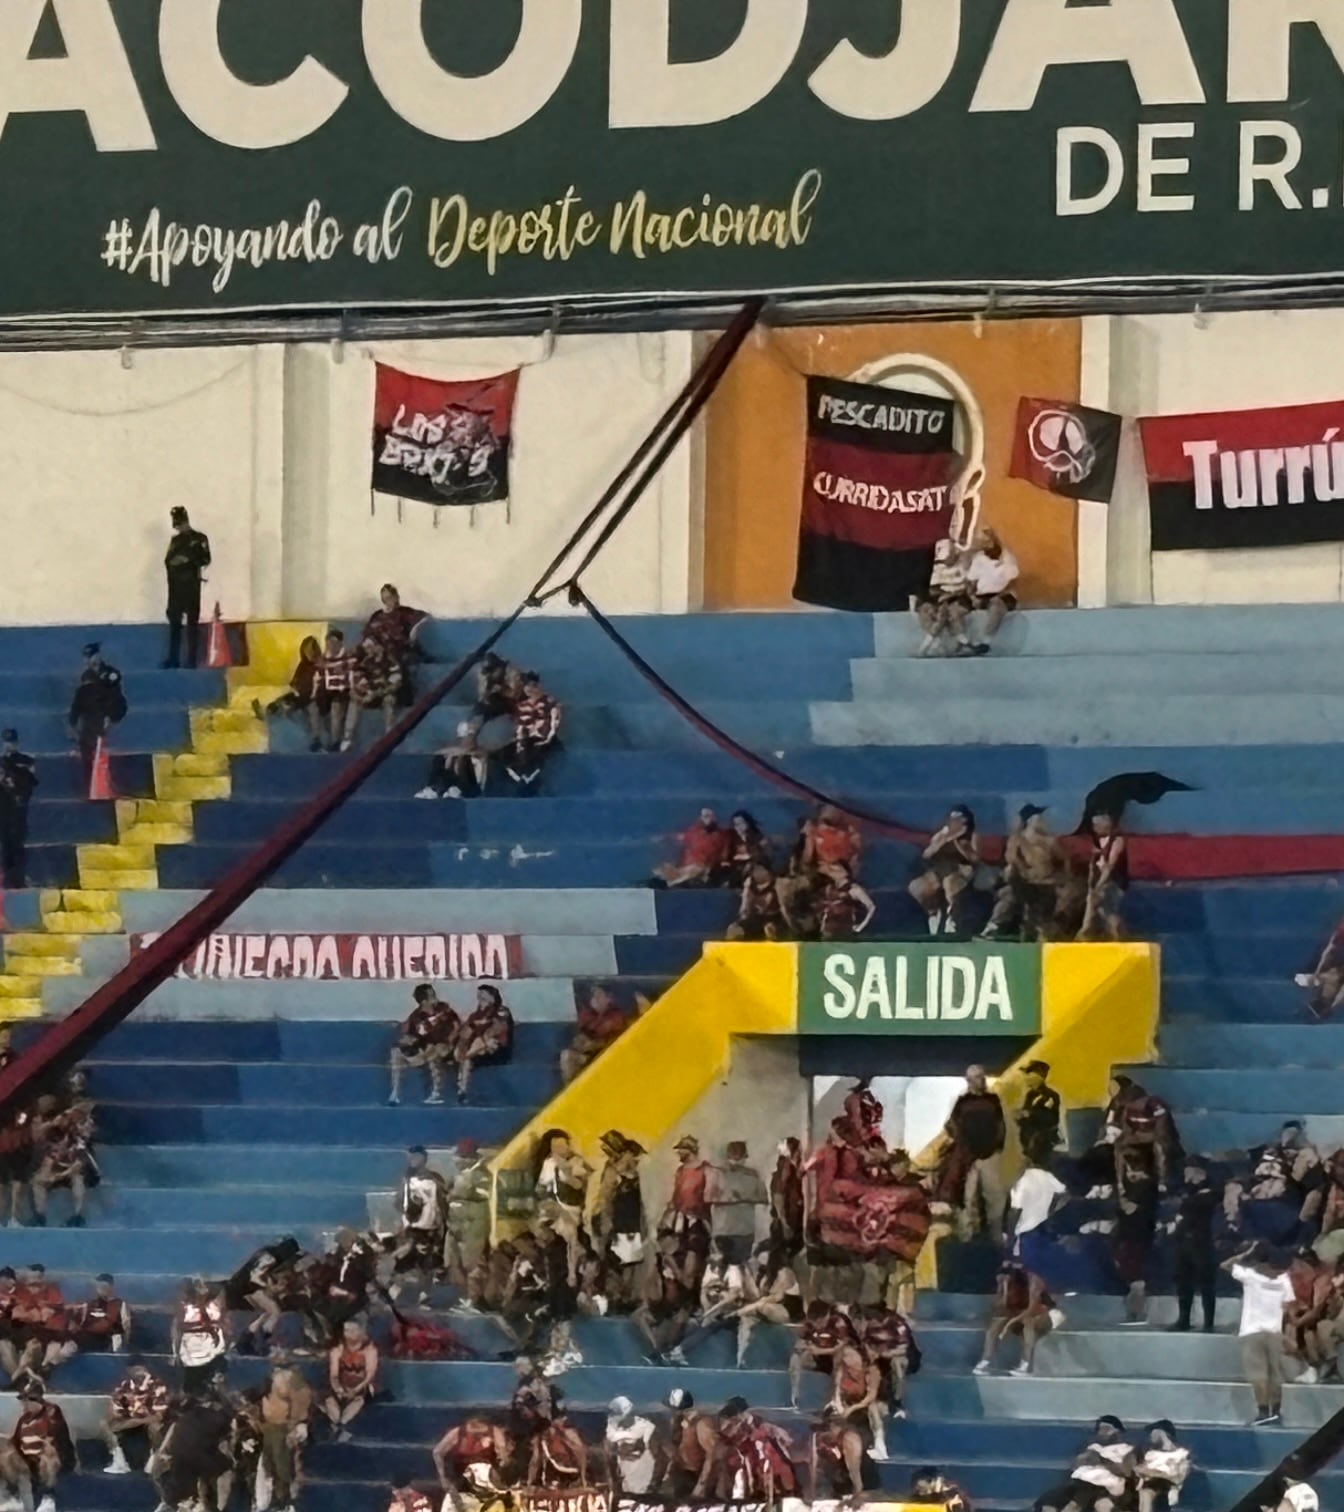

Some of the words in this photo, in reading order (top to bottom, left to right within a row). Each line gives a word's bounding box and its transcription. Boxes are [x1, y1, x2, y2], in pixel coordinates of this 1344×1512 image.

[1055, 122, 1195, 216] DE
[100, 198, 344, 294] #Apoyando
[351, 186, 412, 264] al
[427, 185, 602, 276] Deporte
[608, 168, 823, 261] Nacional
[817, 394, 945, 434] PESCADITO
[822, 954, 1015, 1021] SALIDA
